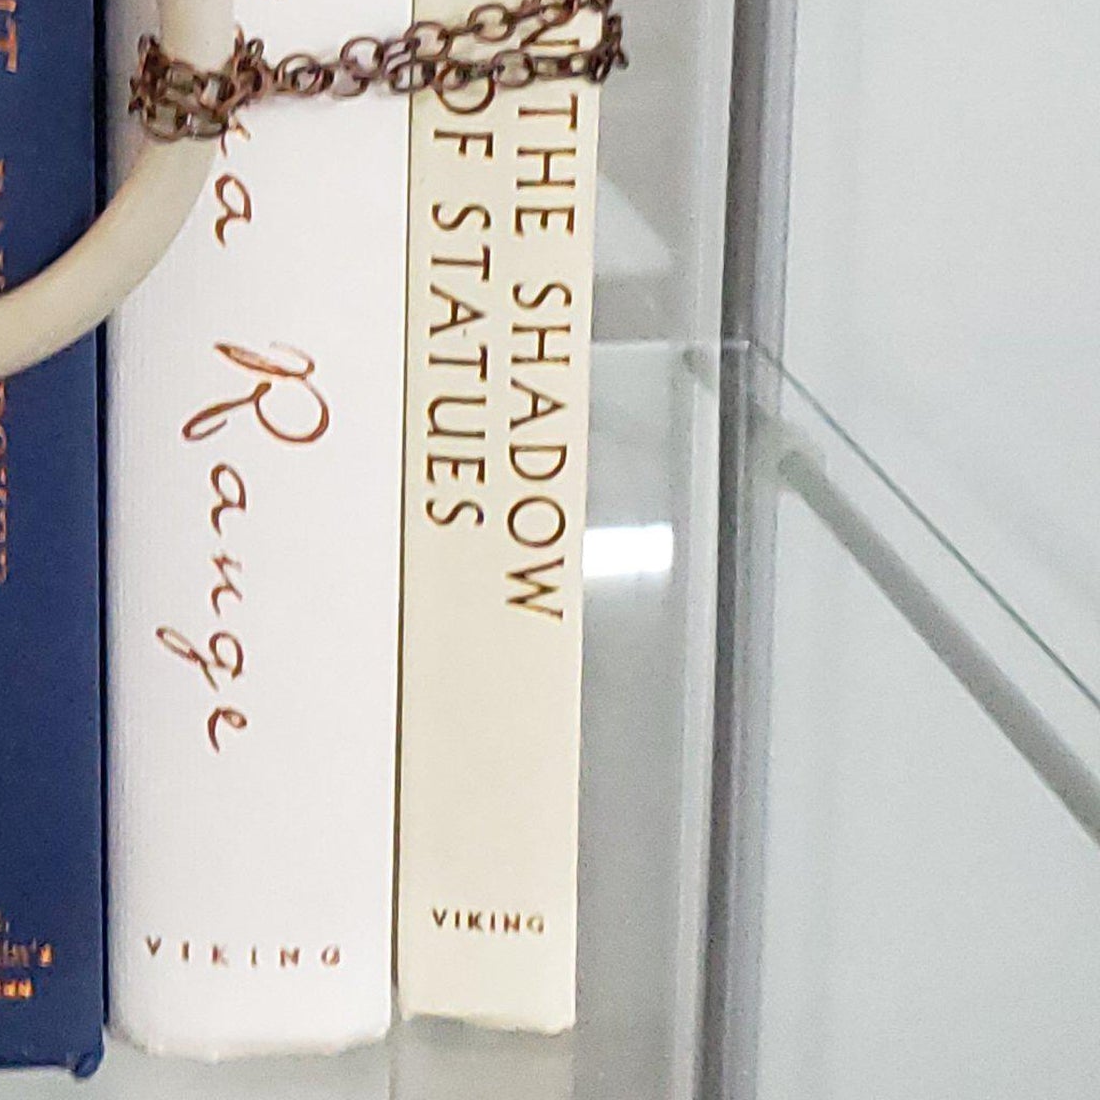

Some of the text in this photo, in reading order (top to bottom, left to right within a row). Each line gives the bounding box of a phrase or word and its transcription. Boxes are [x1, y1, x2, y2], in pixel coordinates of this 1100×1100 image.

[514, 93, 578, 236] THE
[426, 60, 495, 527] OF STATUES
[155, 340, 329, 753] Range
[505, 282, 572, 620] SHADOW
[145, 935, 341, 968] VIKING
[432, 907, 545, 935] VIKING
